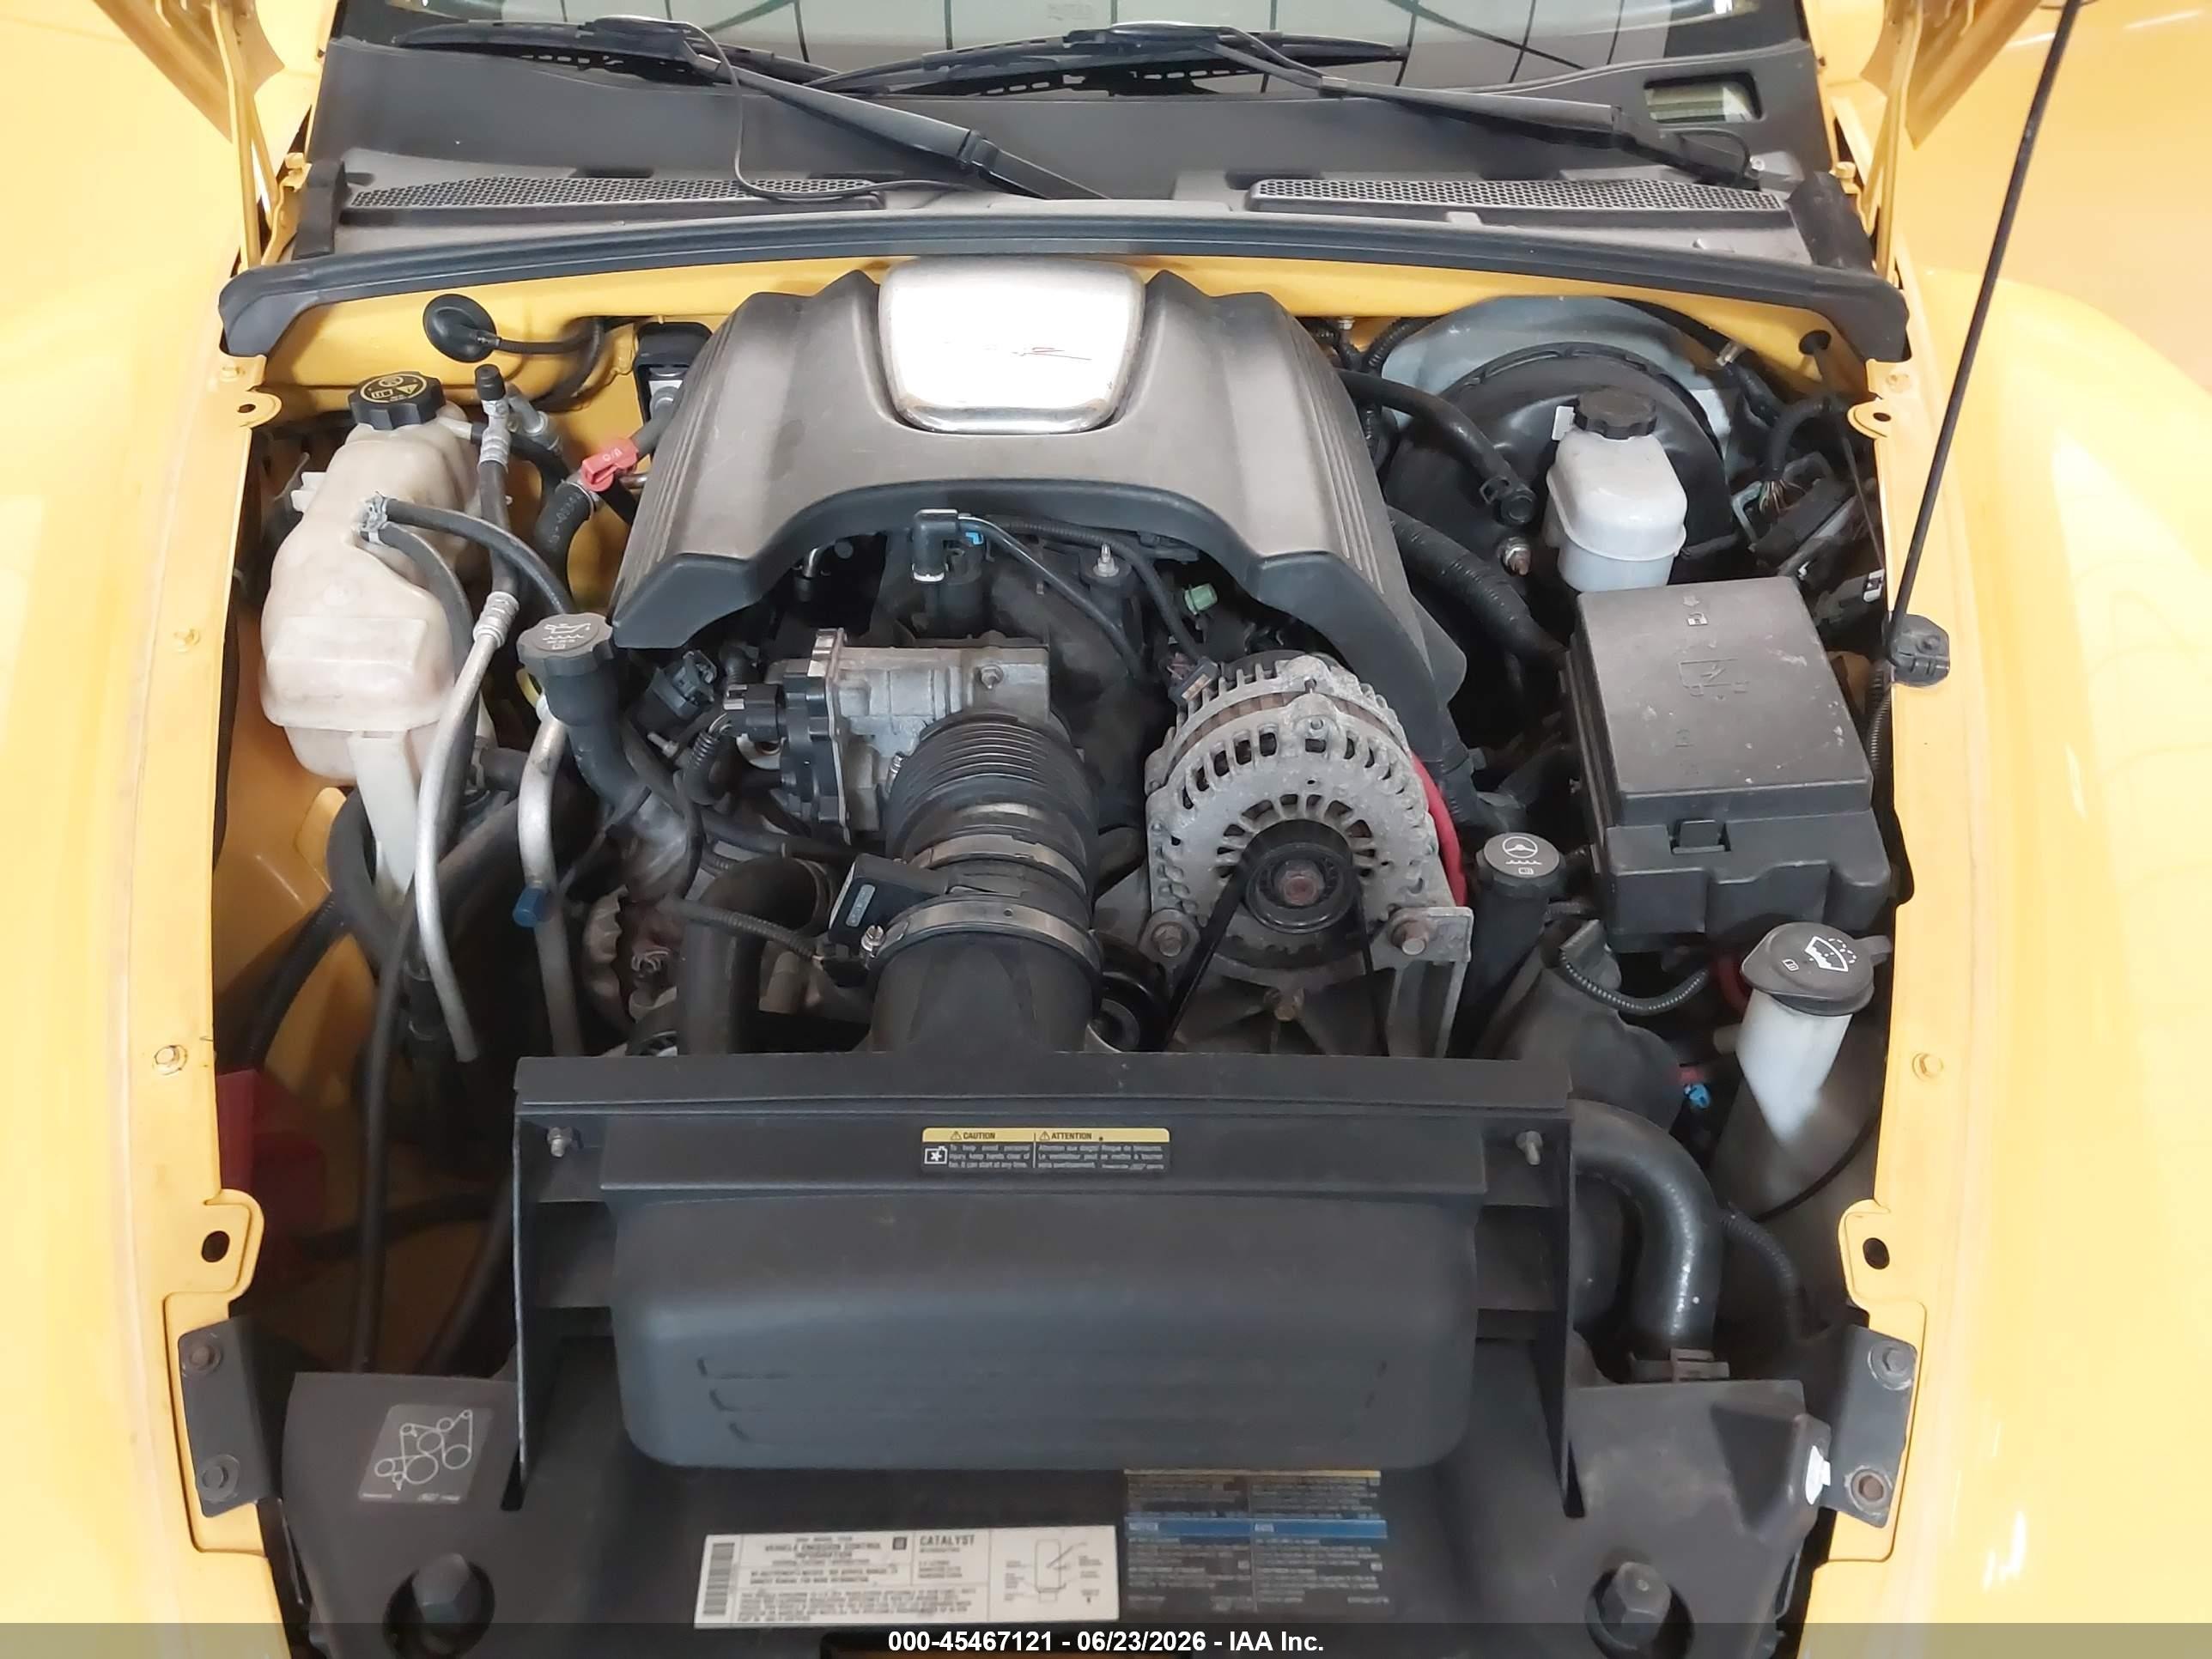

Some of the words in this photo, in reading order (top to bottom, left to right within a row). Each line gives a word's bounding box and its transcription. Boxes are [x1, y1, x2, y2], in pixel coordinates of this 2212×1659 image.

[963, 1132, 996, 1140] CAUTION
[1051, 1132, 1092, 1140] ATTENTION
[920, 1534, 975, 1546] CATALYST
